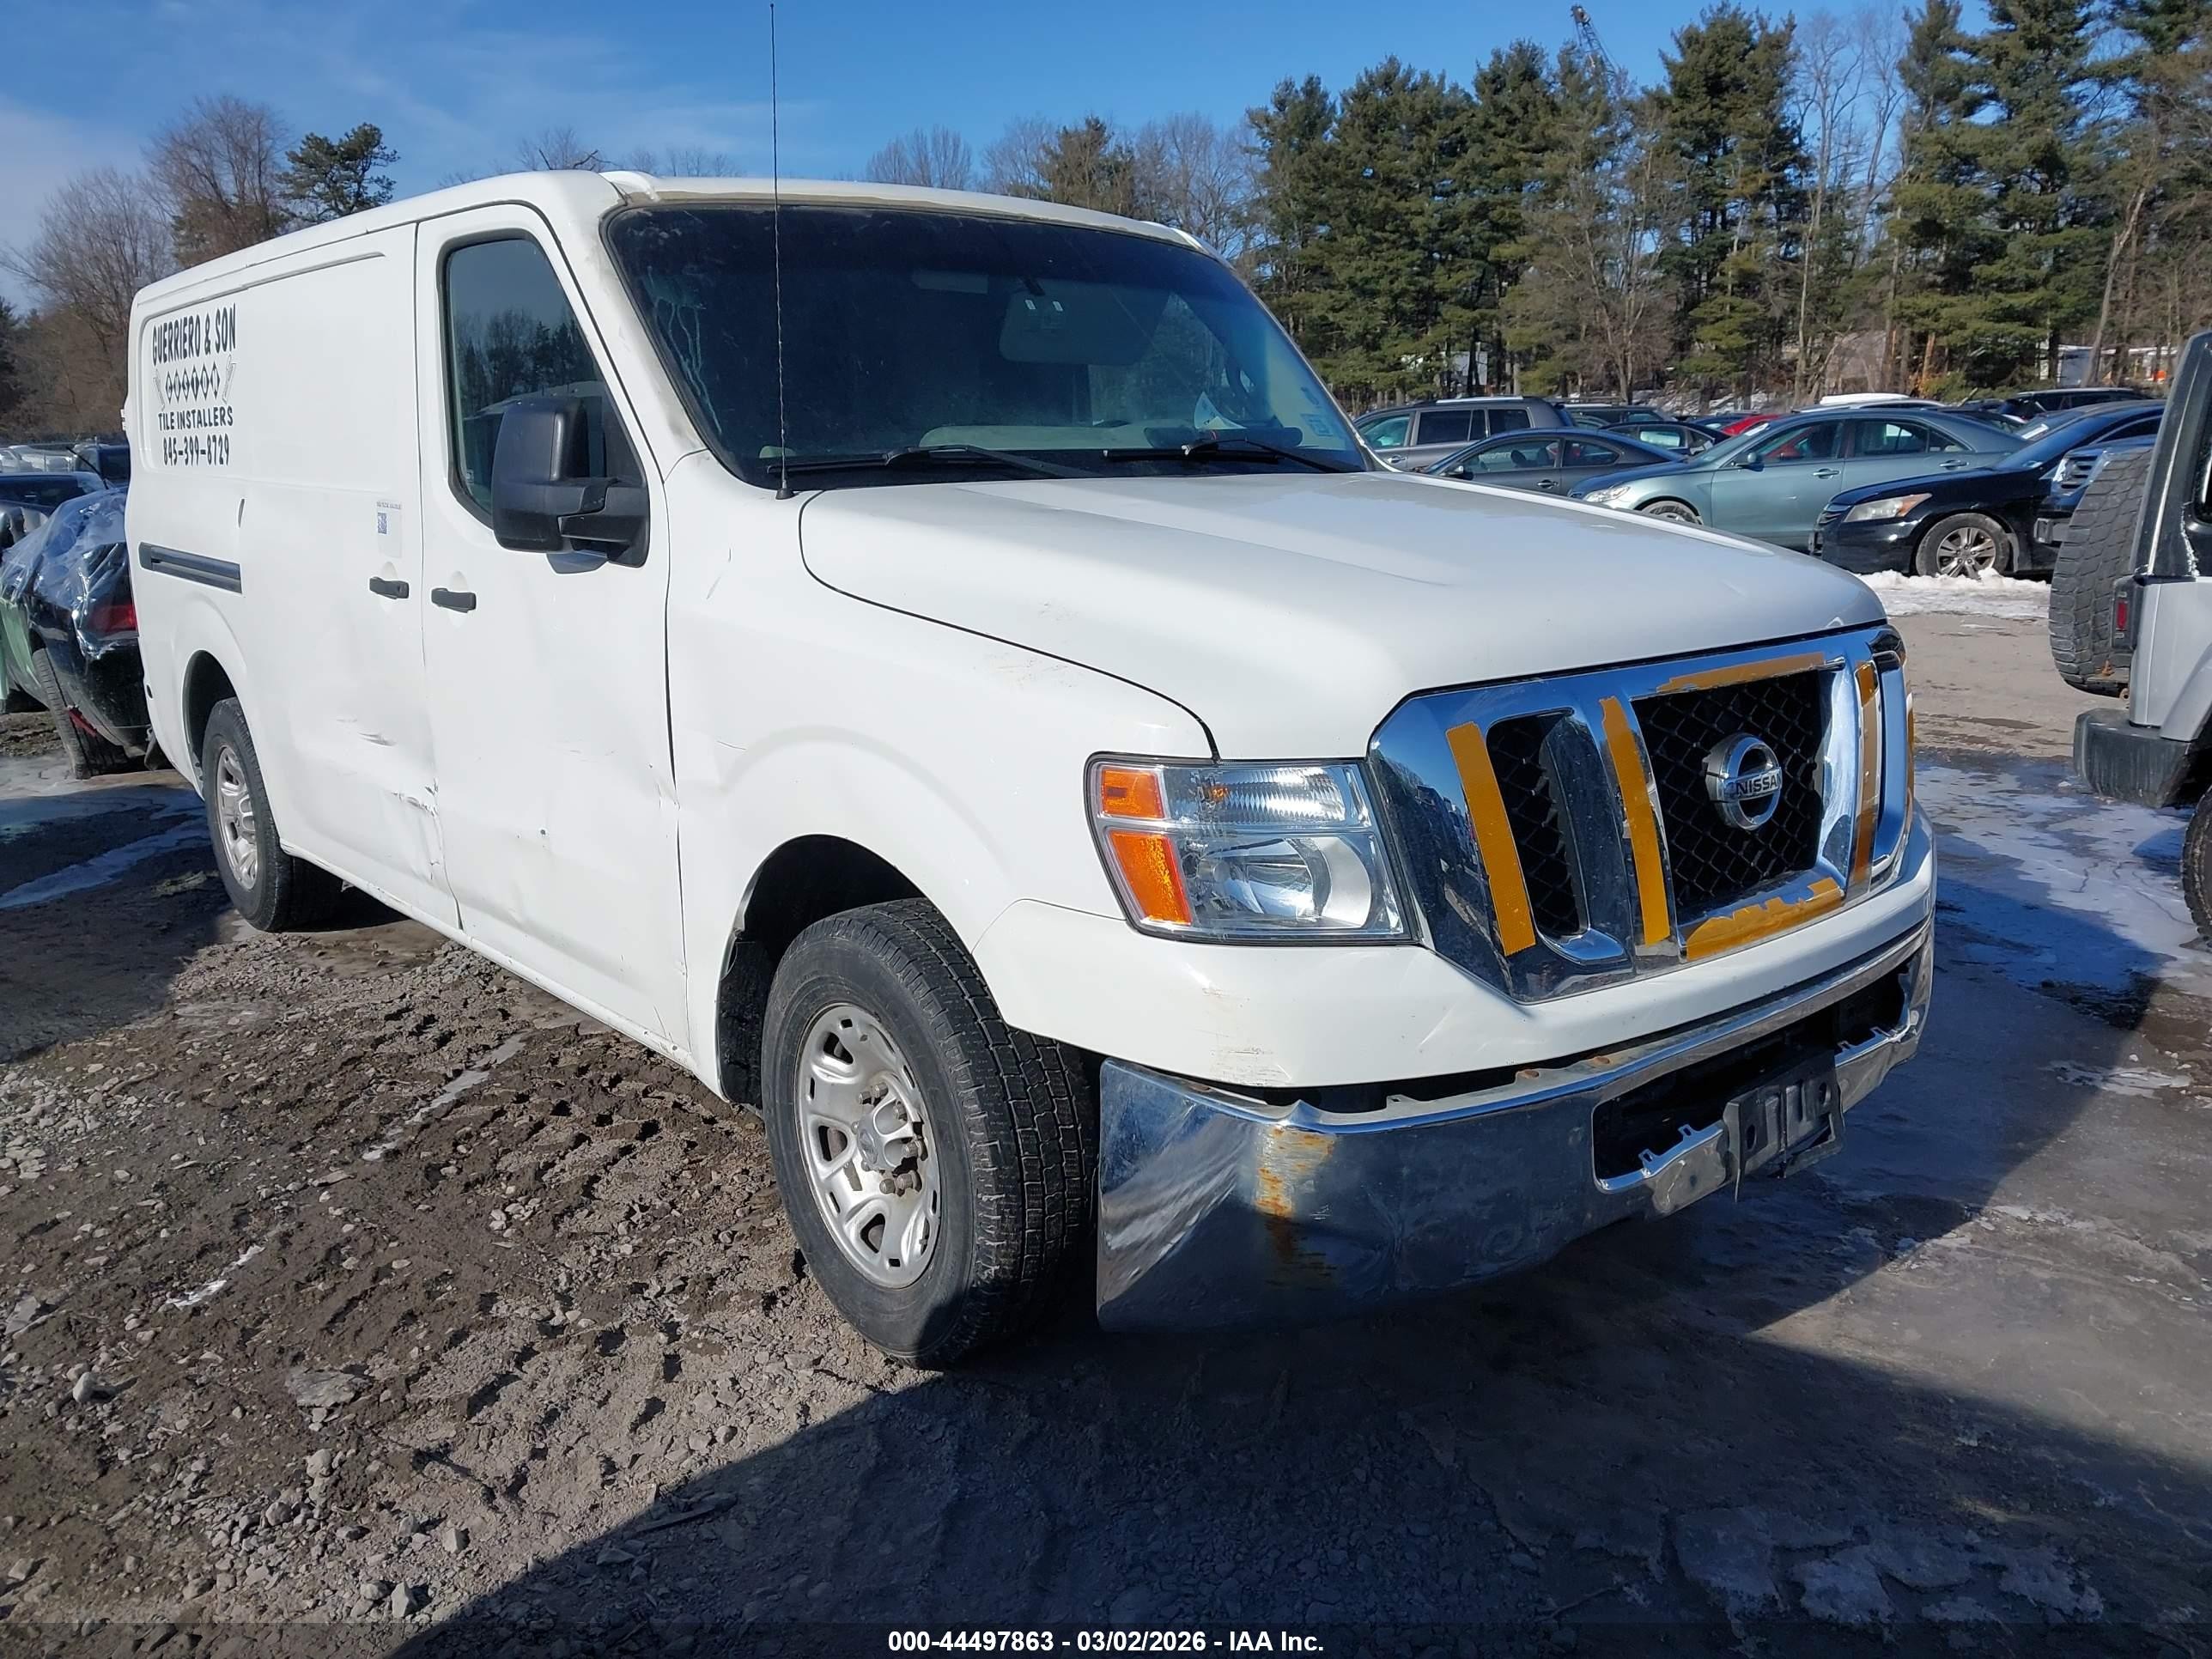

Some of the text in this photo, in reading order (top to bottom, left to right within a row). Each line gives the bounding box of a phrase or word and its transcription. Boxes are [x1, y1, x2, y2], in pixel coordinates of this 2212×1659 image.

[152, 302, 236, 367] GUERRIERO & SON
[158, 405, 234, 431] TILE INSTALLERS
[163, 434, 229, 466] 845-399-8729
[1736, 773, 1781, 794] NISSAN
